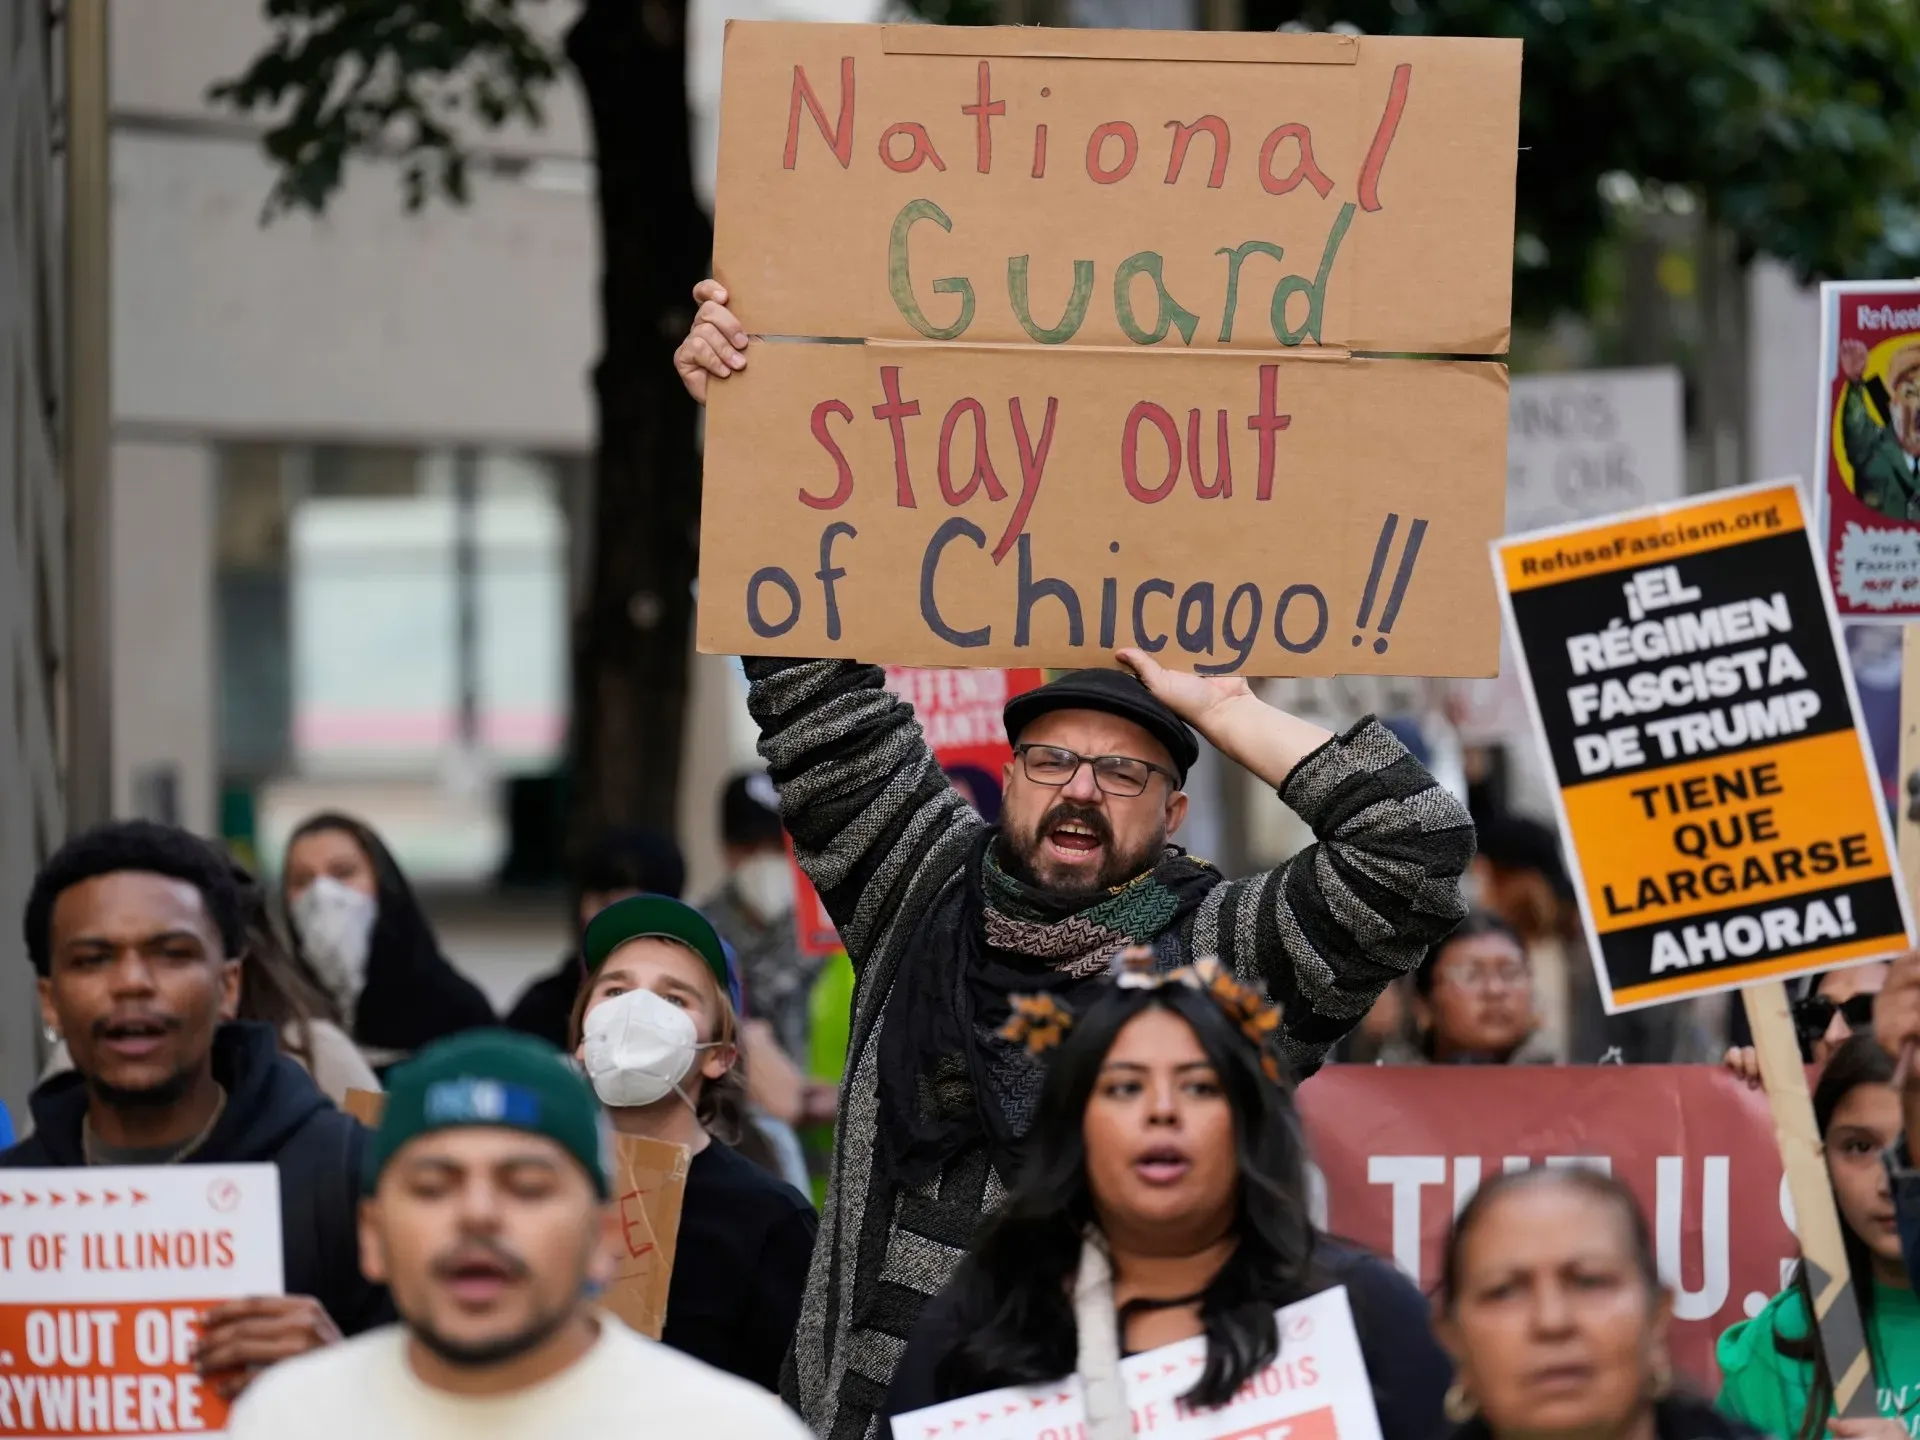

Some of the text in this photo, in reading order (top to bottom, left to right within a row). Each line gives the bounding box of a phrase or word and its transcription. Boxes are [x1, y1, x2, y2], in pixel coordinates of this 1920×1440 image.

[783, 56, 1412, 212] National
[888, 198, 1357, 347] Guard
[1856, 303, 1920, 330] Refuse
[798, 364, 1292, 565] stay out
[745, 521, 858, 641] of
[1521, 504, 1781, 577] RefuseFascism.org
[1566, 592, 1792, 676] RÉGIMEN
[1623, 565, 1701, 622] ¡EL
[1567, 643, 1807, 727] FASCISTA
[1574, 689, 1822, 776] DE TRUMP
[1631, 762, 1784, 820] TIENE
[1603, 833, 1873, 917] LARGARSE
[1673, 808, 1779, 859] QUE
[1650, 895, 1857, 974] AHORA!
[28, 1233, 67, 1271] OF
[82, 1229, 236, 1271] ILLINOIS
[1655, 1156, 1803, 1321] U.
[25, 1307, 201, 1367] OUT OF
